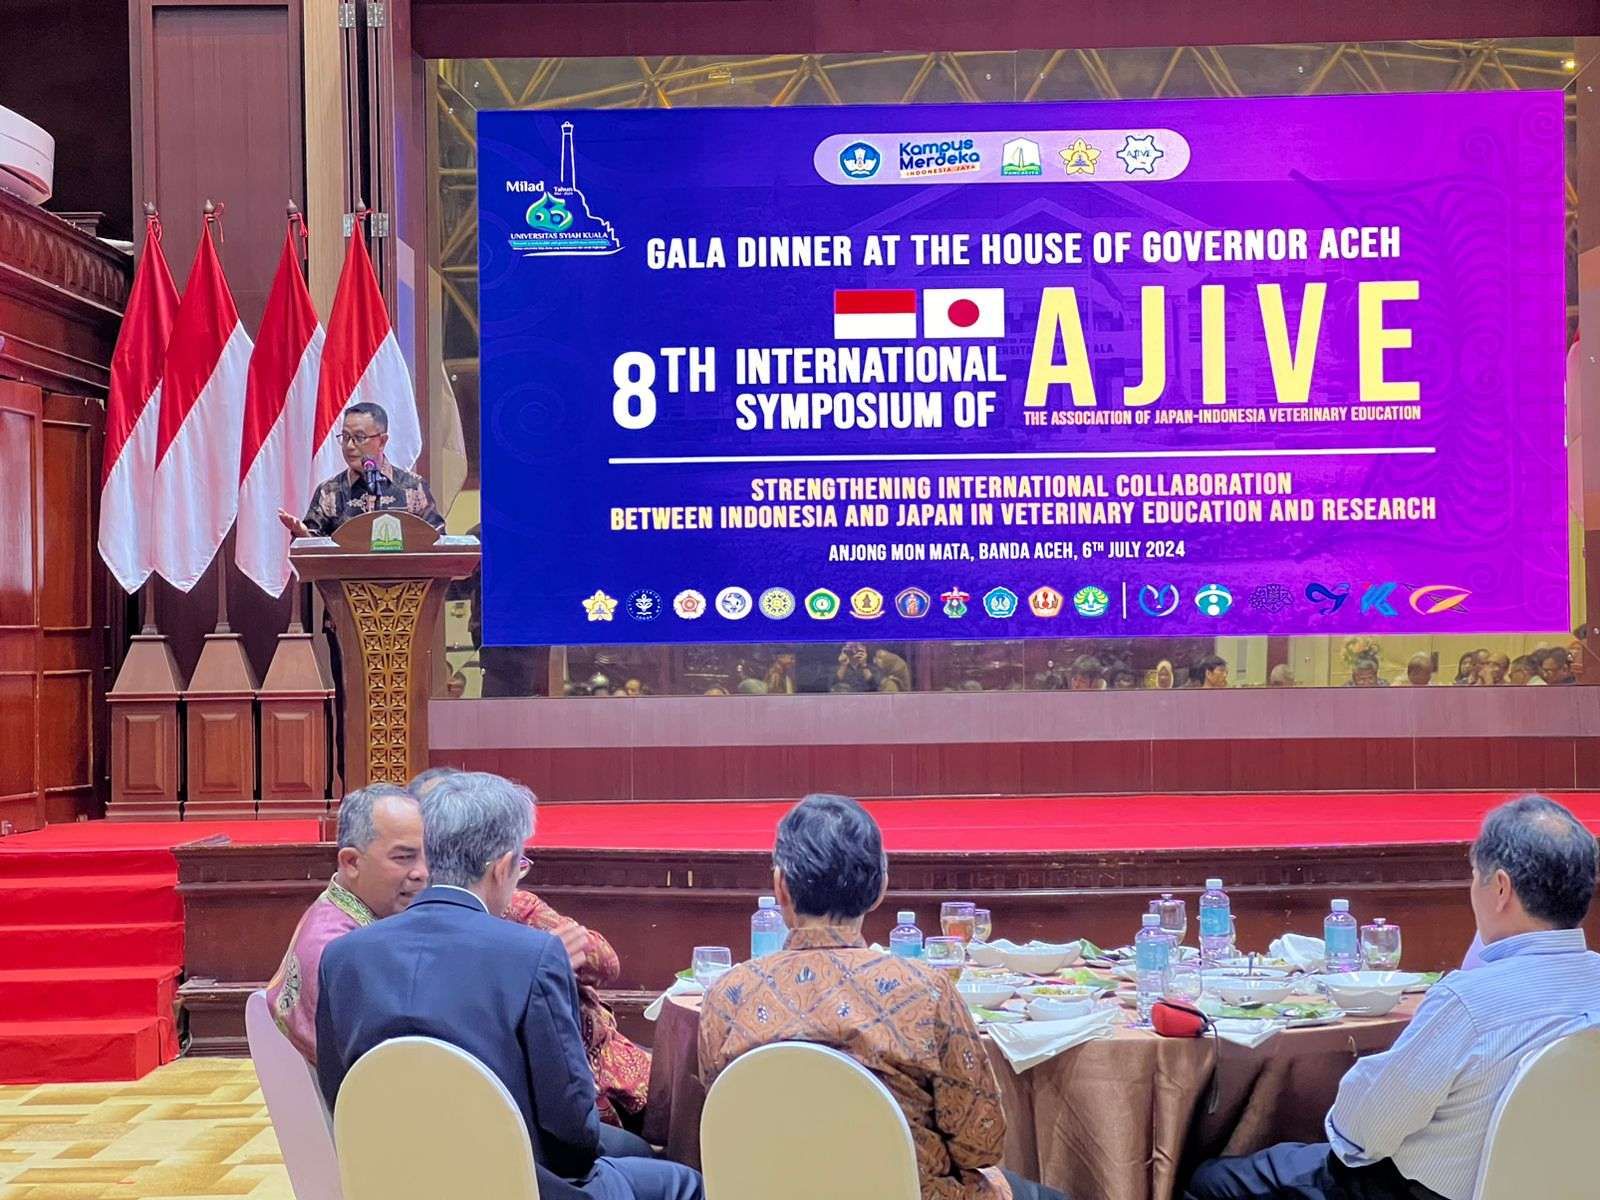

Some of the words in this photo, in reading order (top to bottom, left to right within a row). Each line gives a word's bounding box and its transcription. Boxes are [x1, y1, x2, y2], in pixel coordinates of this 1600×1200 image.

[900, 139, 974, 157] Kampus
[900, 150, 981, 170] Merdeka
[906, 166, 952, 176] INDONESIA
[506, 181, 545, 192] Milad
[510, 232, 558, 240] UNIVERSITAS
[583, 231, 609, 239] KUALA
[647, 237, 726, 269] GALA
[738, 236, 851, 268] DINNER
[864, 235, 900, 266] AT
[911, 234, 969, 265] THE
[982, 233, 1082, 264] HOUSE
[1094, 231, 1131, 263] OF
[1143, 229, 1307, 262] GOVERNOR
[1319, 226, 1401, 260] ACEH
[1024, 280, 1421, 407] AJIVE
[735, 346, 1007, 385] INTERNATIONAL
[735, 392, 943, 431] SYMPOSIUM
[953, 391, 997, 428] OF
[1023, 411, 1047, 426] THE
[1051, 410, 1132, 425] ASSOCIATION
[1135, 409, 1151, 424] OF
[1154, 408, 1266, 424] JAPAN-INDONESIA
[1269, 407, 1348, 423] VETERINARY
[1351, 405, 1421, 421] EDUCATION
[751, 476, 931, 501] STRENGTHENING
[938, 474, 1109, 499] INTERNATIONAL
[1116, 472, 1293, 497] COLLABORATION
[610, 507, 713, 531] BETWEEN
[720, 505, 838, 529] INDONESIA
[845, 504, 889, 527] AND
[896, 503, 962, 527] JAPAN
[971, 502, 993, 525] IN
[1002, 501, 1134, 525] VETERINARY
[1142, 499, 1262, 524] EDUCATION
[1270, 498, 1314, 522] AND
[1322, 497, 1436, 521] RESEARCH
[828, 544, 887, 562] ANJONG
[891, 544, 925, 561] MON
[929, 543, 975, 562] MATA,
[978, 543, 1030, 560] BANDA
[1034, 542, 1078, 560] ACEH,
[1108, 541, 1141, 558] JULY
[1145, 540, 1186, 558] 2024
